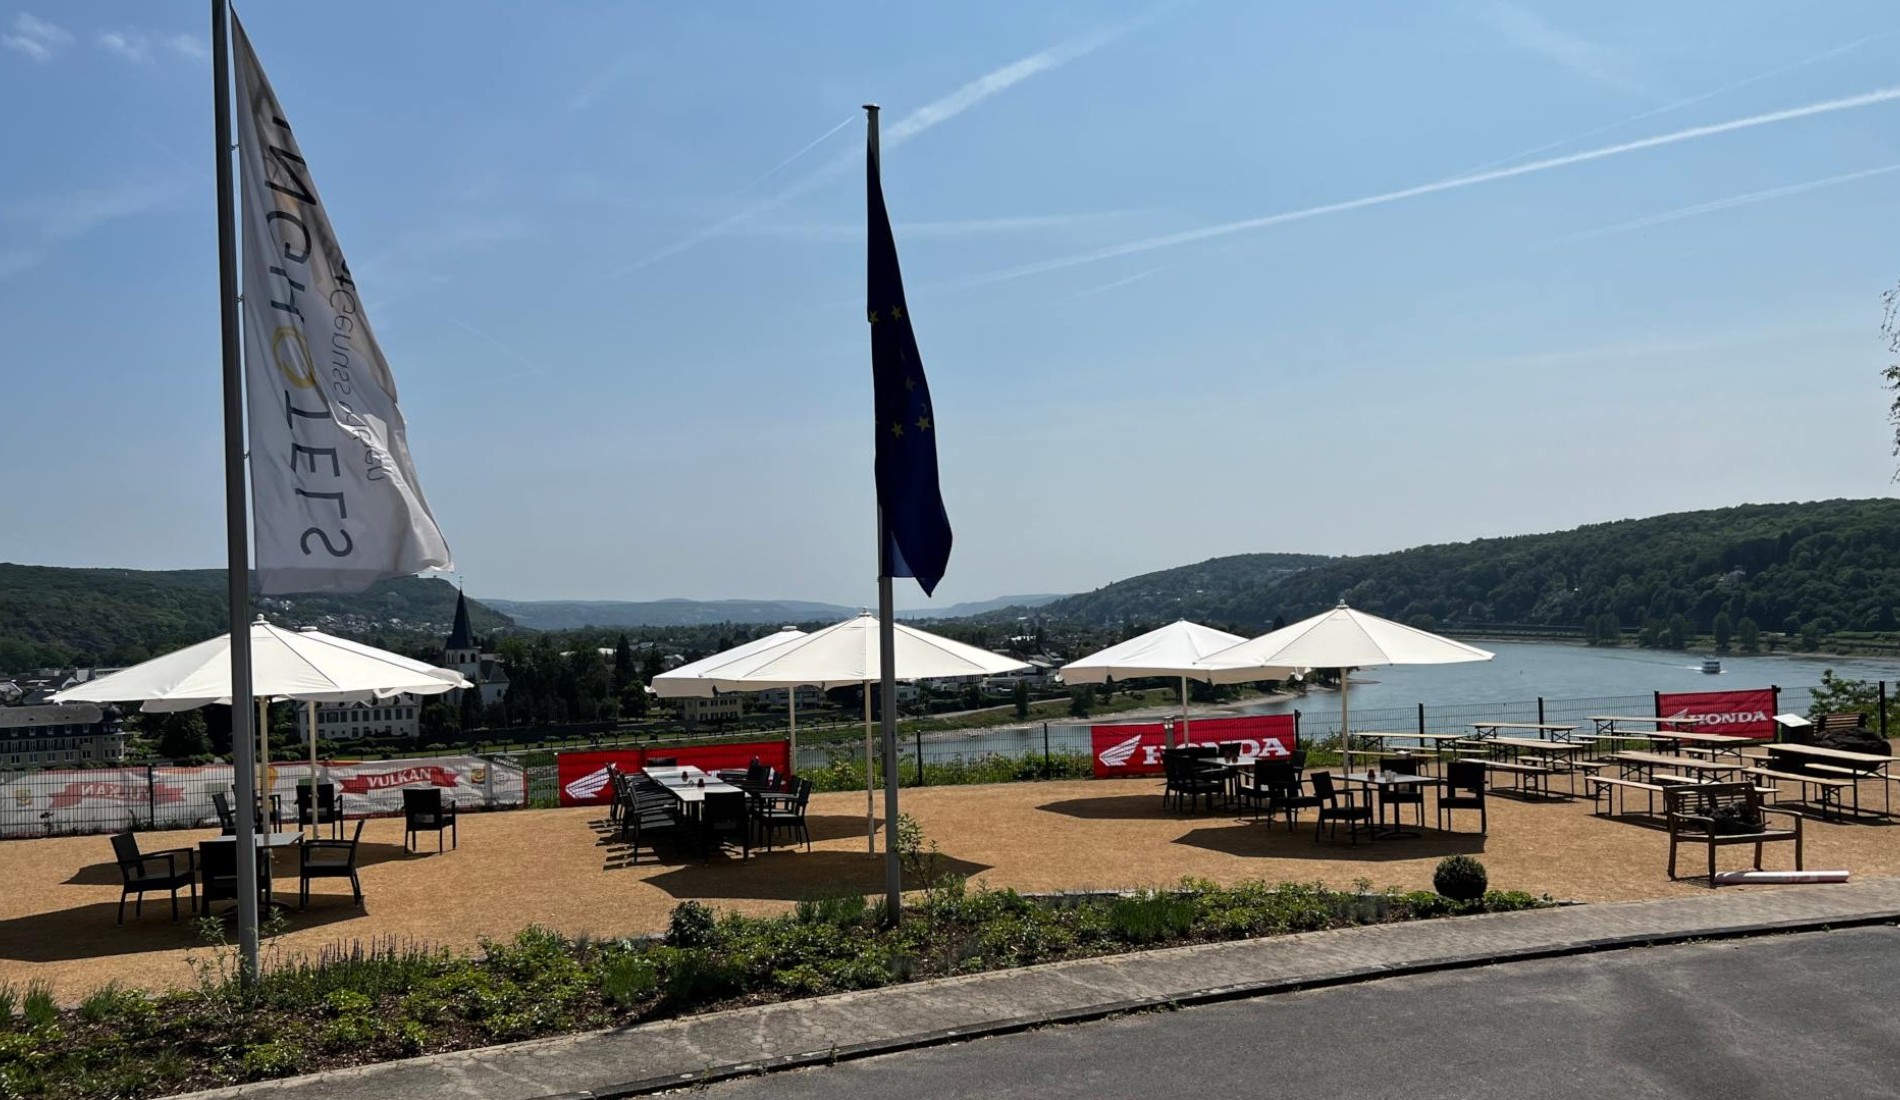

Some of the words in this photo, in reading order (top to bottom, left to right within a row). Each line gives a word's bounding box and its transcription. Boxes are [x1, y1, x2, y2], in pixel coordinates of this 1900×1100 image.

[1688, 710, 1768, 725] HONDA
[1142, 737, 1291, 765] HDA
[366, 768, 432, 788] VULKAN
